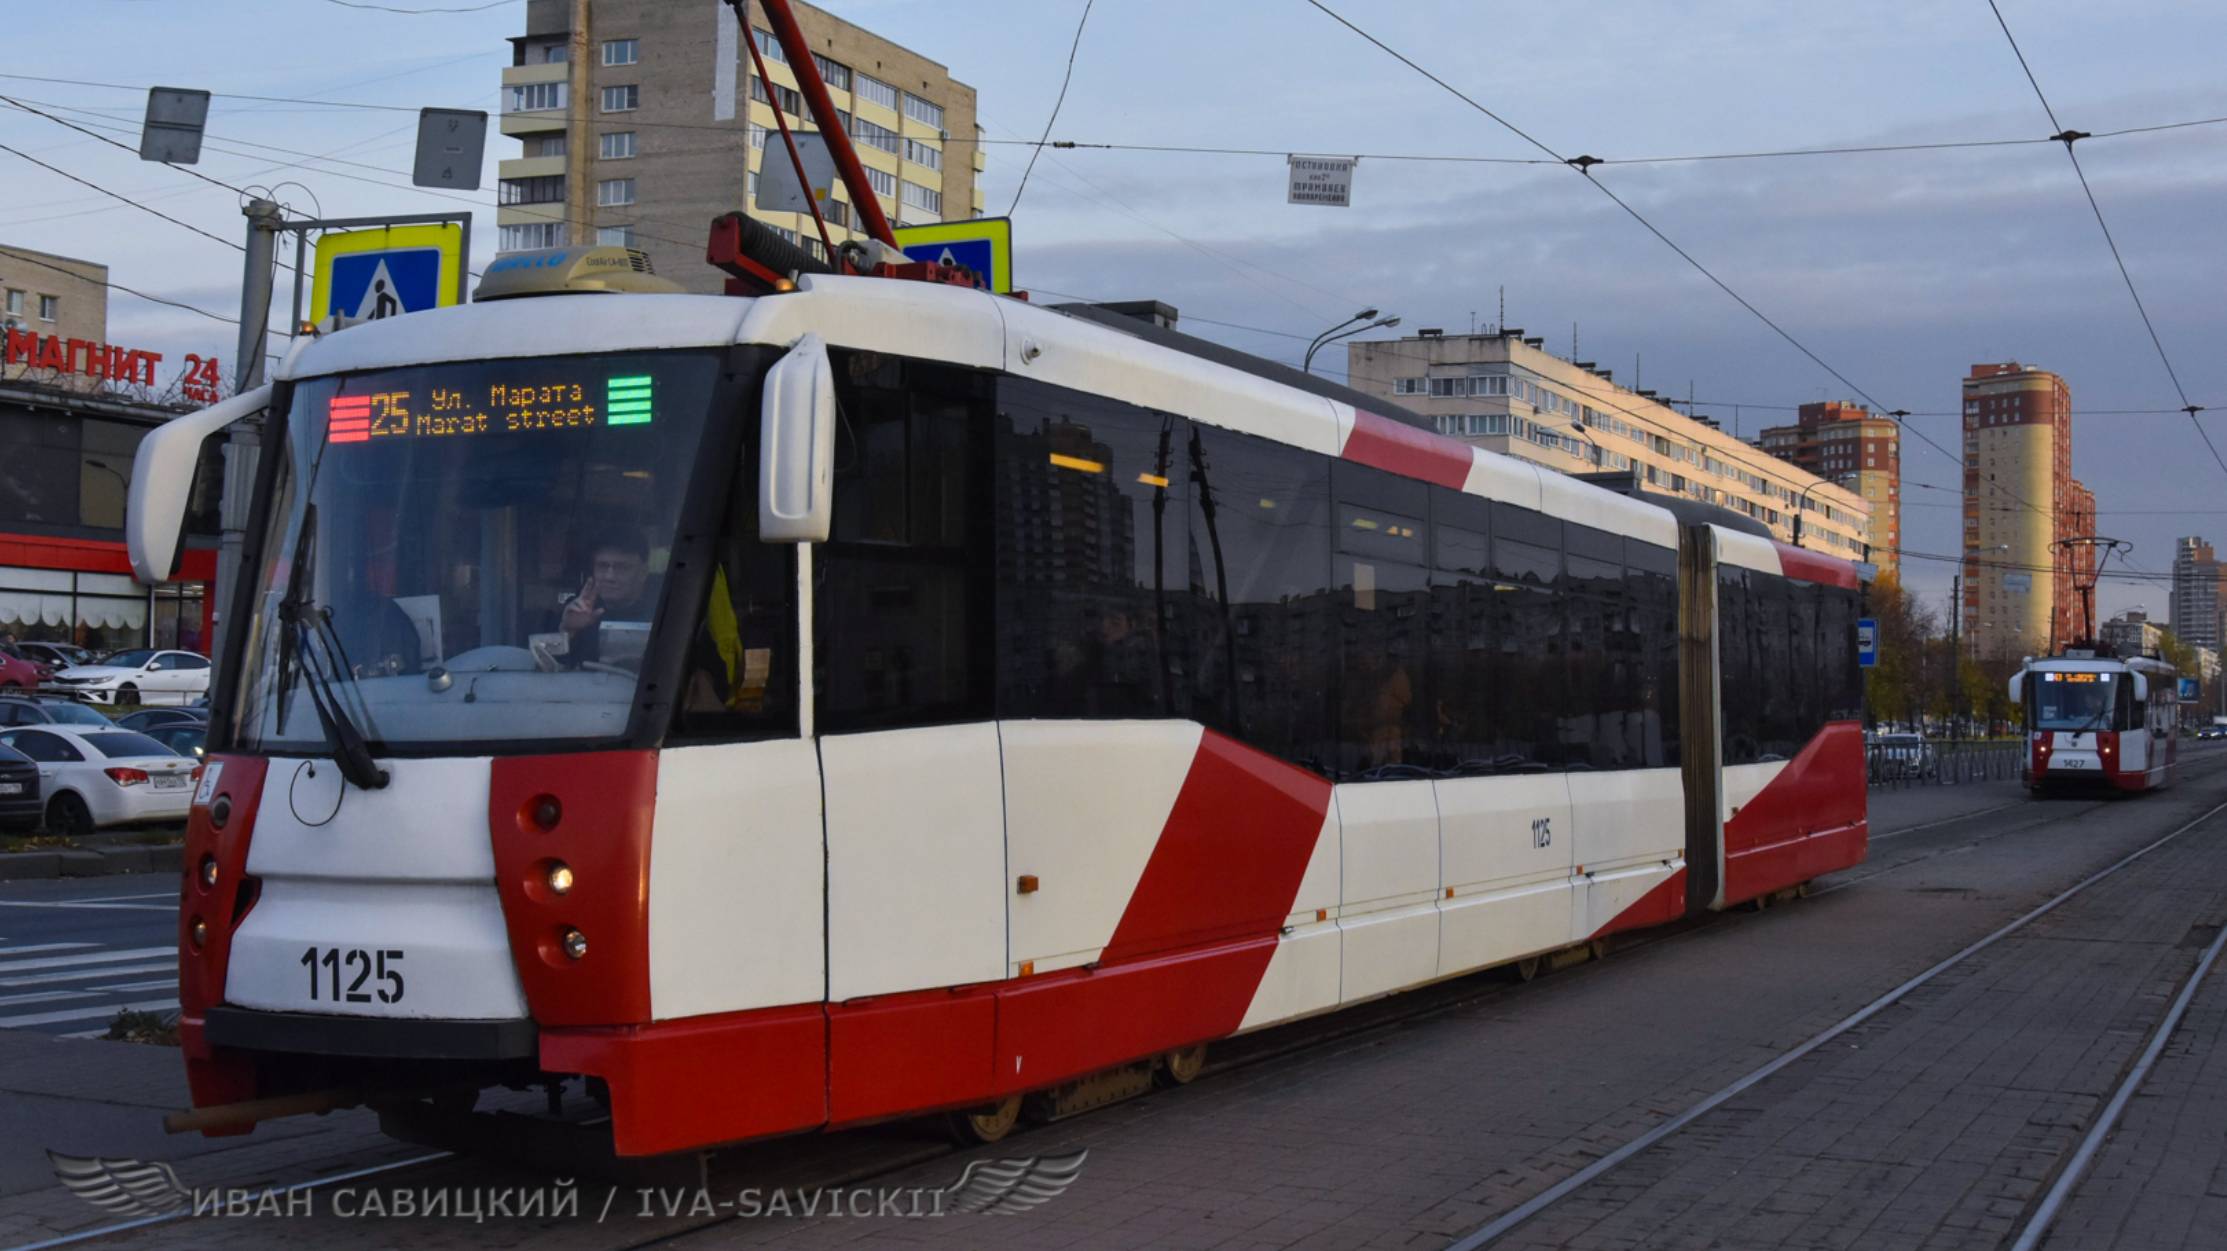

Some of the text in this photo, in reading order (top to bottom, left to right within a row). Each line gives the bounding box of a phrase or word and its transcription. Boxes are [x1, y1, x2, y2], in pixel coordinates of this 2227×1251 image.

[6, 327, 163, 386] МАГНИТ
[184, 353, 219, 387] 24
[371, 391, 410, 436] 25
[432, 384, 583, 410] Ул. Марата
[416, 405, 595, 436] Marat street
[1531, 817, 1552, 849] 1125
[300, 946, 405, 1004] 1125
